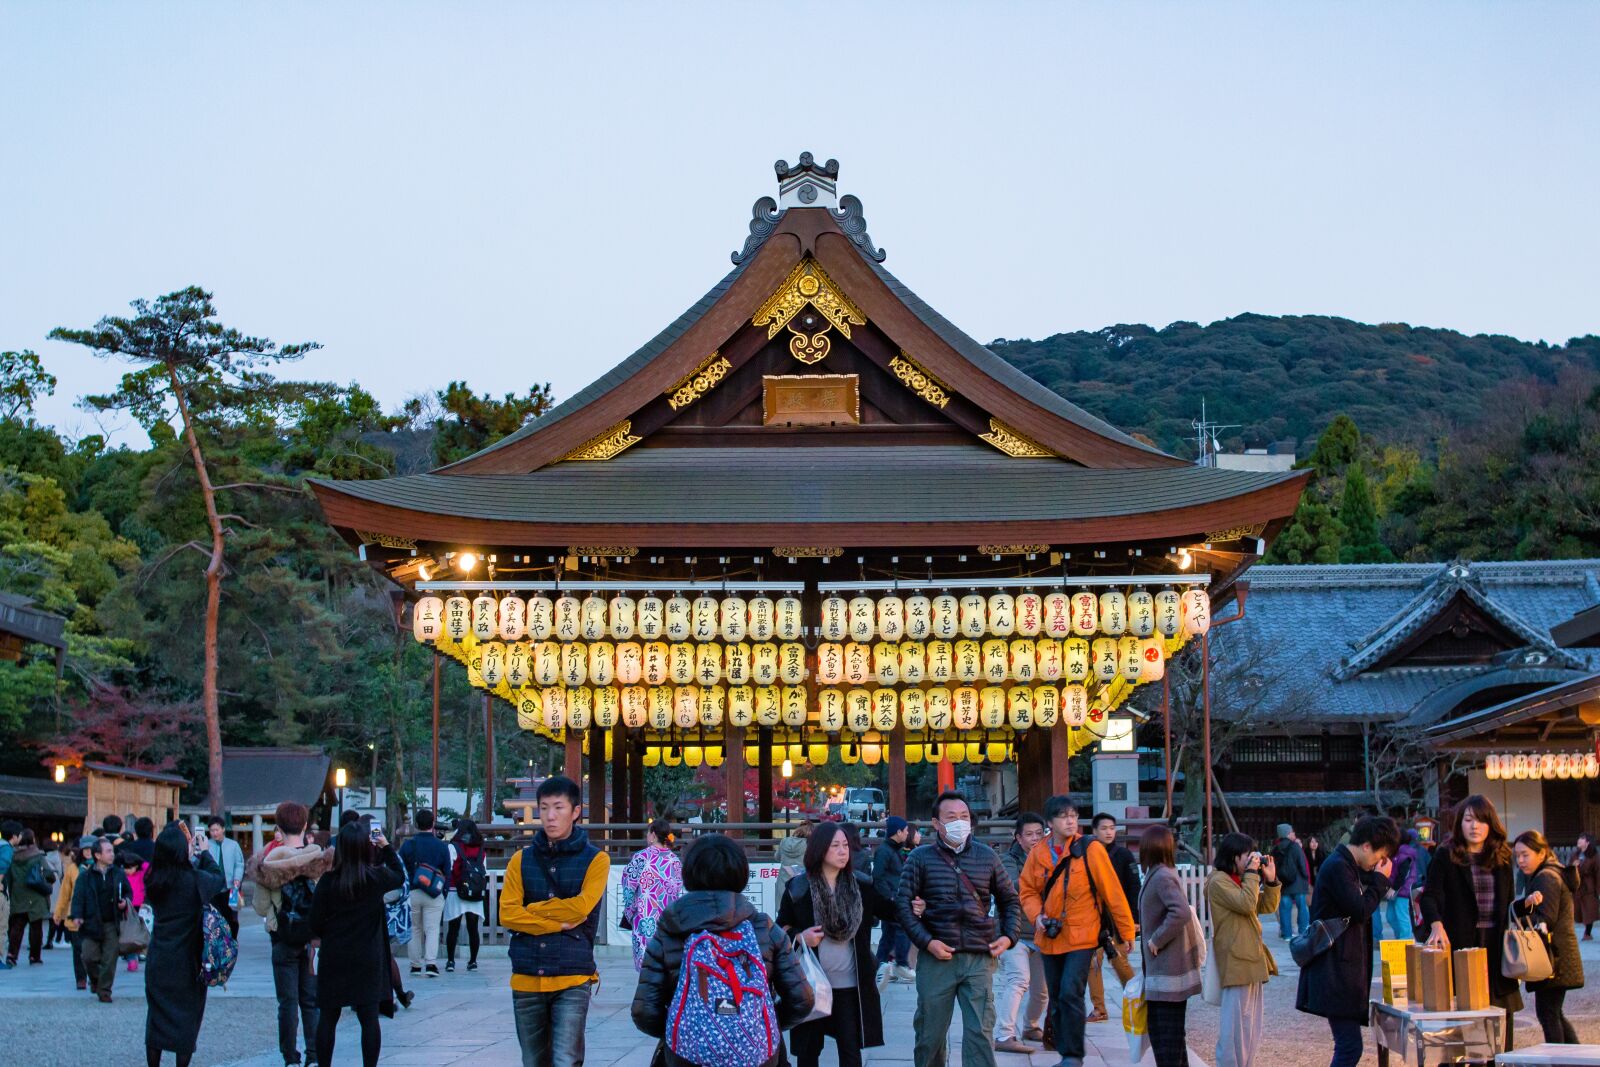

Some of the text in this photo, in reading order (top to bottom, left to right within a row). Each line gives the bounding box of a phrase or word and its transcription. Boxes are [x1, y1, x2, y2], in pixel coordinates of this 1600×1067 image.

[451, 600, 463, 636] 家田荘子
[532, 600, 544, 636] たまや
[562, 599, 573, 635] 富美代
[617, 602, 629, 634] いし初
[644, 601, 658, 635] 堀八重
[728, 601, 740, 636] ふく葉
[757, 599, 767, 637] 宮川町歌舞会
[784, 599, 795, 637] 宮川町歌舞会
[856, 603, 868, 635] 花染
[885, 602, 898, 635] 花染
[942, 599, 952, 635] まつもと
[968, 598, 981, 633] 叶恵
[996, 598, 1009, 627] えん
[1023, 596, 1036, 631] 富美芳
[1052, 597, 1066, 632] 富美苑
[1110, 595, 1121, 630] よし富美
[1137, 595, 1150, 633] 桂あす香
[1164, 594, 1175, 632] 桂あす香
[487, 644, 499, 681] ゑり善
[510, 643, 523, 681] ゑり善
[567, 644, 580, 682] ゑり善
[648, 644, 659, 682] 松井本館
[676, 646, 688, 679] 繁乃家
[701, 656, 715, 681] 松本
[787, 645, 800, 678] 富久家
[880, 647, 894, 677] 小花
[936, 643, 948, 677] 豆千佳
[963, 642, 975, 677] 久富美
[989, 645, 1004, 678] 花傳
[1019, 643, 1031, 677] 小扇
[1046, 642, 1058, 676] 叶千沙
[1070, 642, 1083, 674] 叶家
[1103, 652, 1114, 674] 天塩
[1129, 656, 1139, 673] 和田
[826, 692, 836, 726] カトレヤ
[879, 692, 894, 727] 柳笑会
[961, 690, 972, 725] 堀田芳史
[1015, 690, 1030, 723] 大晃
[760, 868, 779, 879] 厄年
